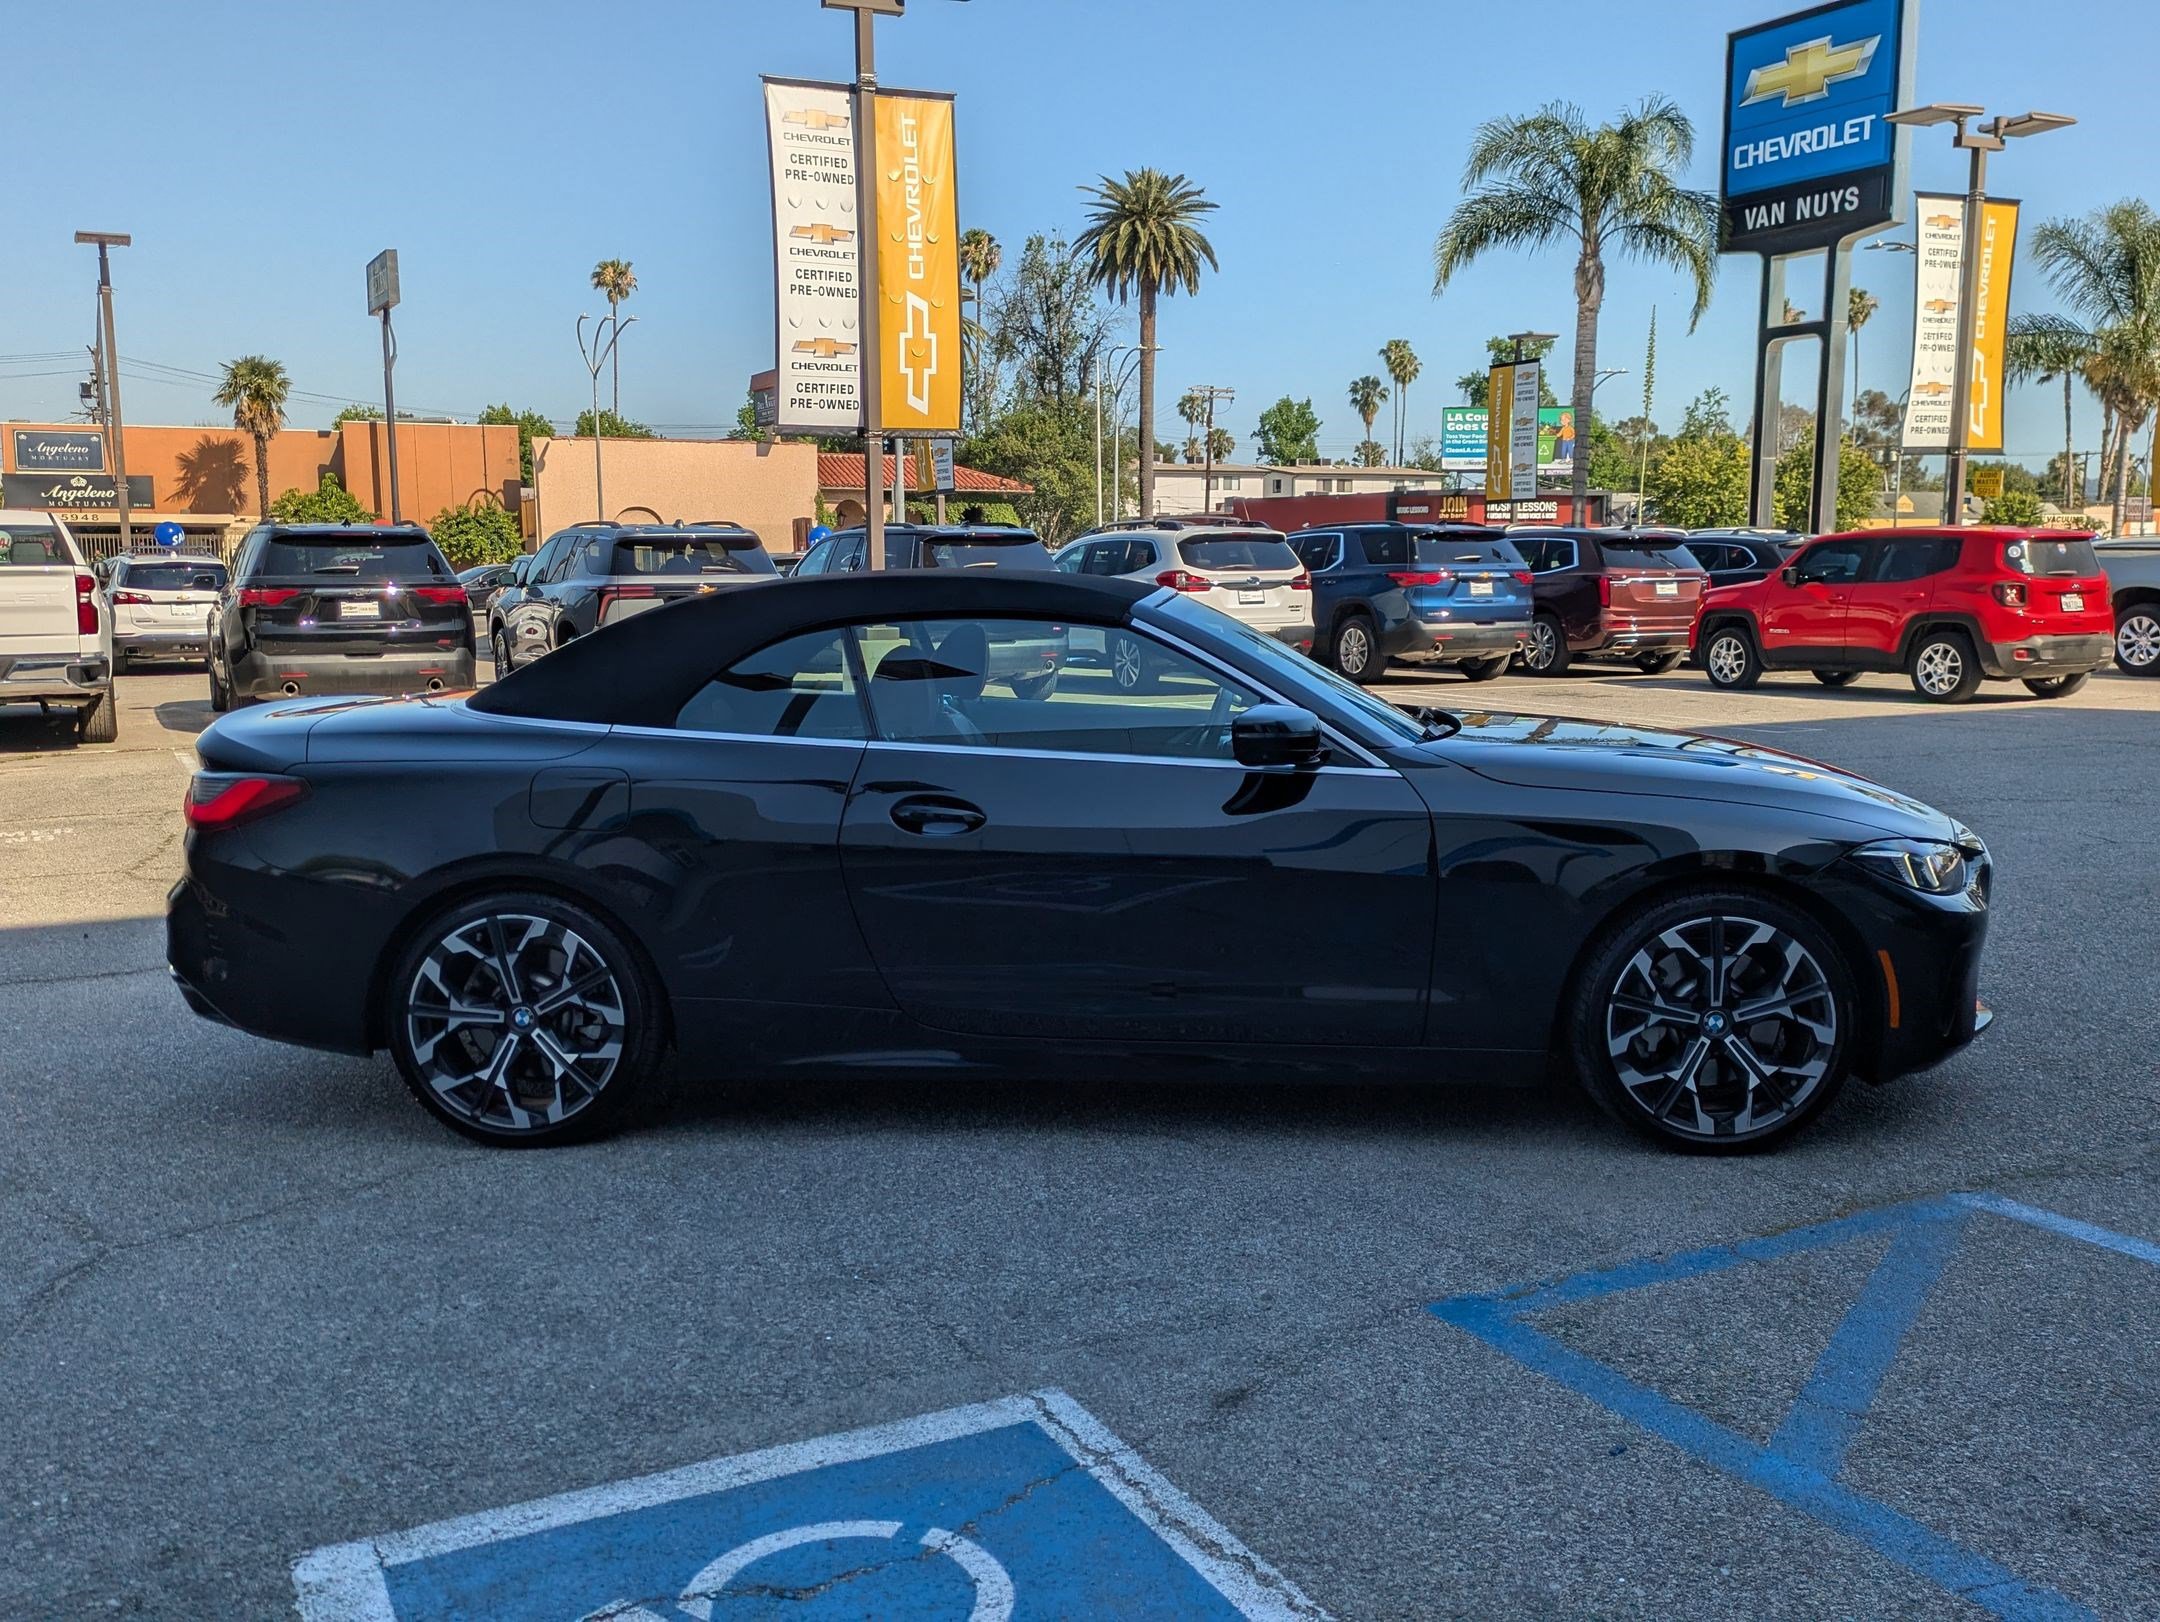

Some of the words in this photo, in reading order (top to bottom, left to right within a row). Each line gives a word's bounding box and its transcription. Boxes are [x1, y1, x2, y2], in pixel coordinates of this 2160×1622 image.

[784, 132, 852, 146] CHEVROLET
[1734, 114, 1876, 169] CHEVROLET
[790, 153, 848, 169] CERTIFIED
[785, 169, 854, 185] PRE-OWNED
[900, 112, 925, 280] CHEVROLET
[1745, 201, 1785, 231] VAN
[1796, 186, 1859, 221] NUYS
[789, 247, 857, 260] CHEVROLET
[795, 268, 853, 283] CERTIFIED
[1975, 214, 1998, 339] CHEVROLET
[790, 284, 858, 299] PRE-OWNED
[791, 361, 858, 373] CHEVROLET
[796, 382, 854, 395] CERTIFIED
[790, 399, 859, 410] PRE-OWNED
[1447, 413, 1463, 421] LA
[1465, 413, 1488, 422] Cou
[1915, 415, 1947, 423] CERTIFIED
[1446, 422, 1478, 431] Goes
[28, 442, 89, 456] Angeleno
[41, 484, 117, 502] Angeleno
[1440, 496, 1468, 513] JOIN
[1487, 503, 1511, 512] MUSI
[1517, 501, 1558, 512] LESSONS
